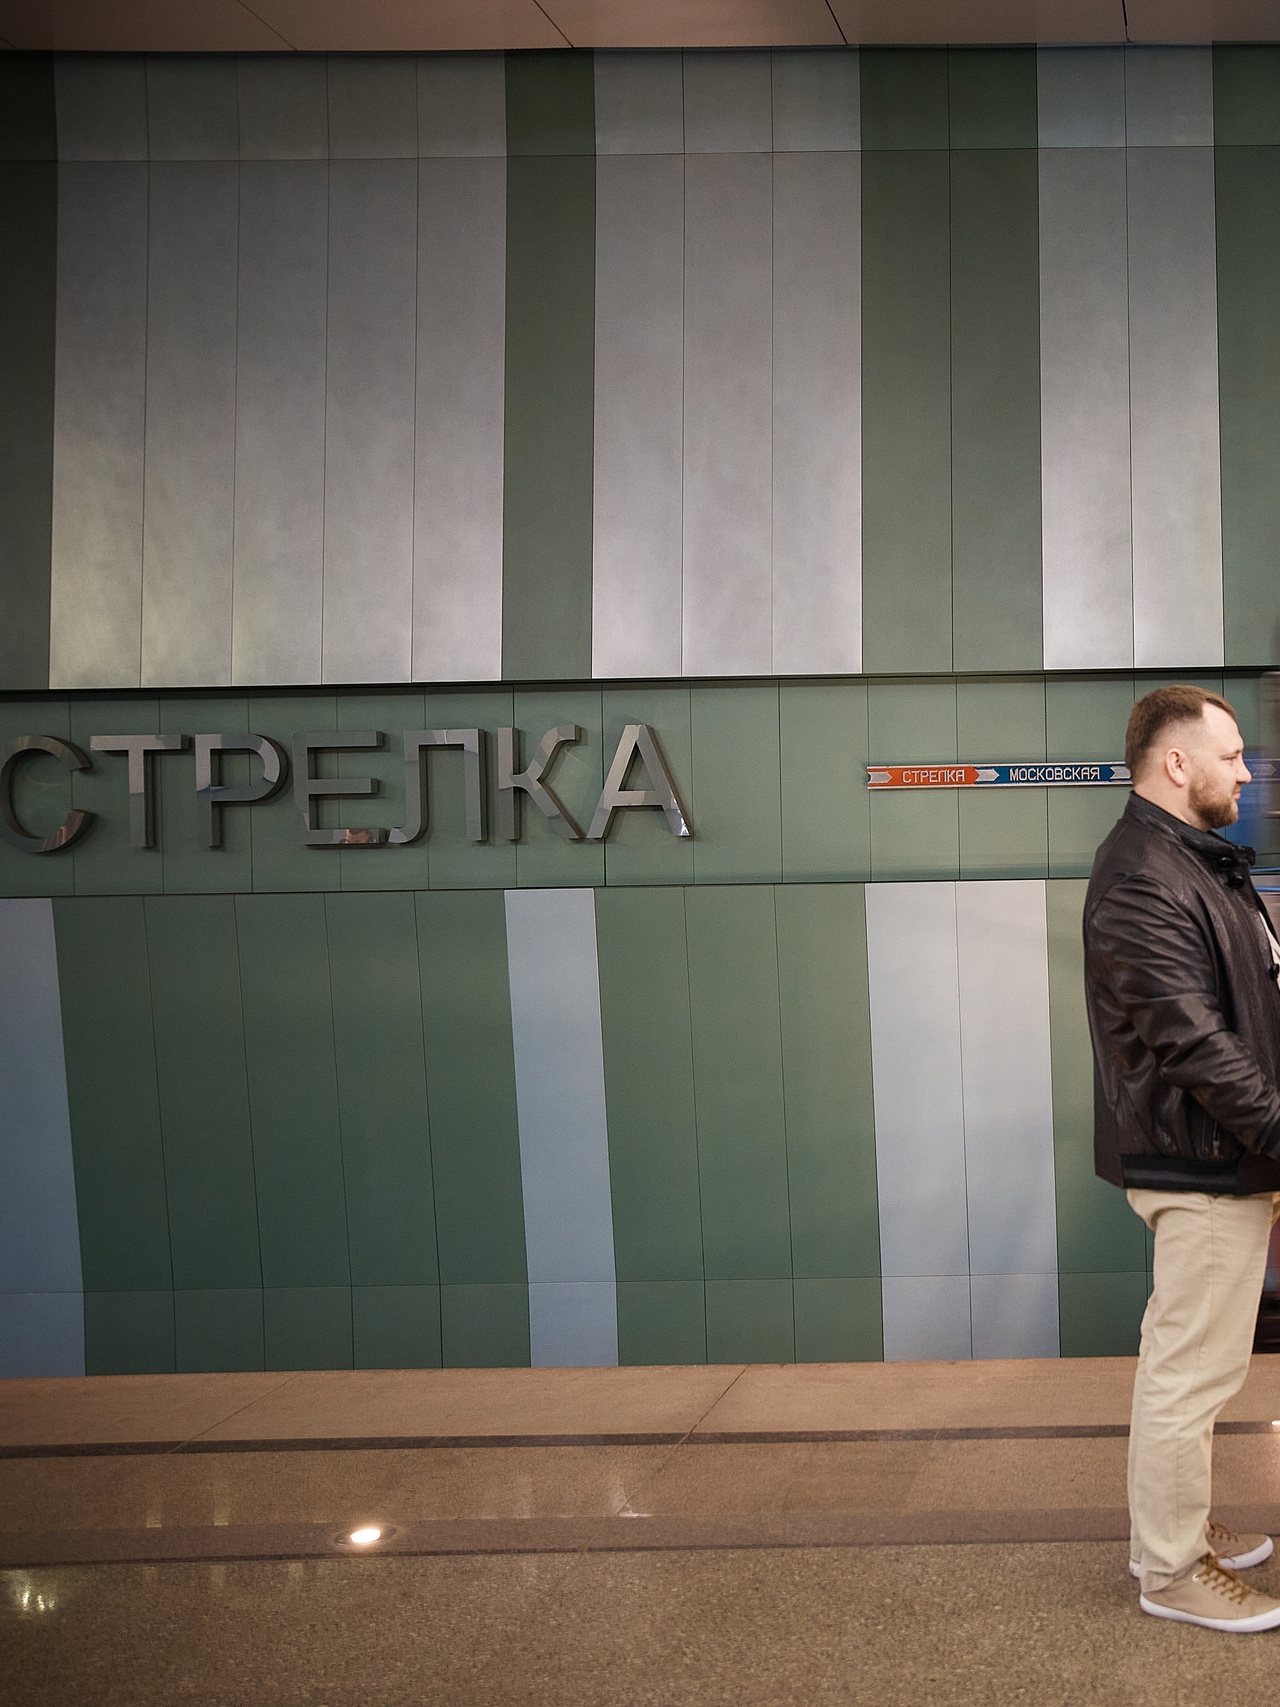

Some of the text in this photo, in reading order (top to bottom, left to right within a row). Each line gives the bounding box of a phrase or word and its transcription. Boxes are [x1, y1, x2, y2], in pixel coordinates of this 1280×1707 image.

[0, 724, 692, 854] СТРЕЛКА
[902, 767, 1101, 783] СТРЕЛКА МОСКОВСКАЯ
